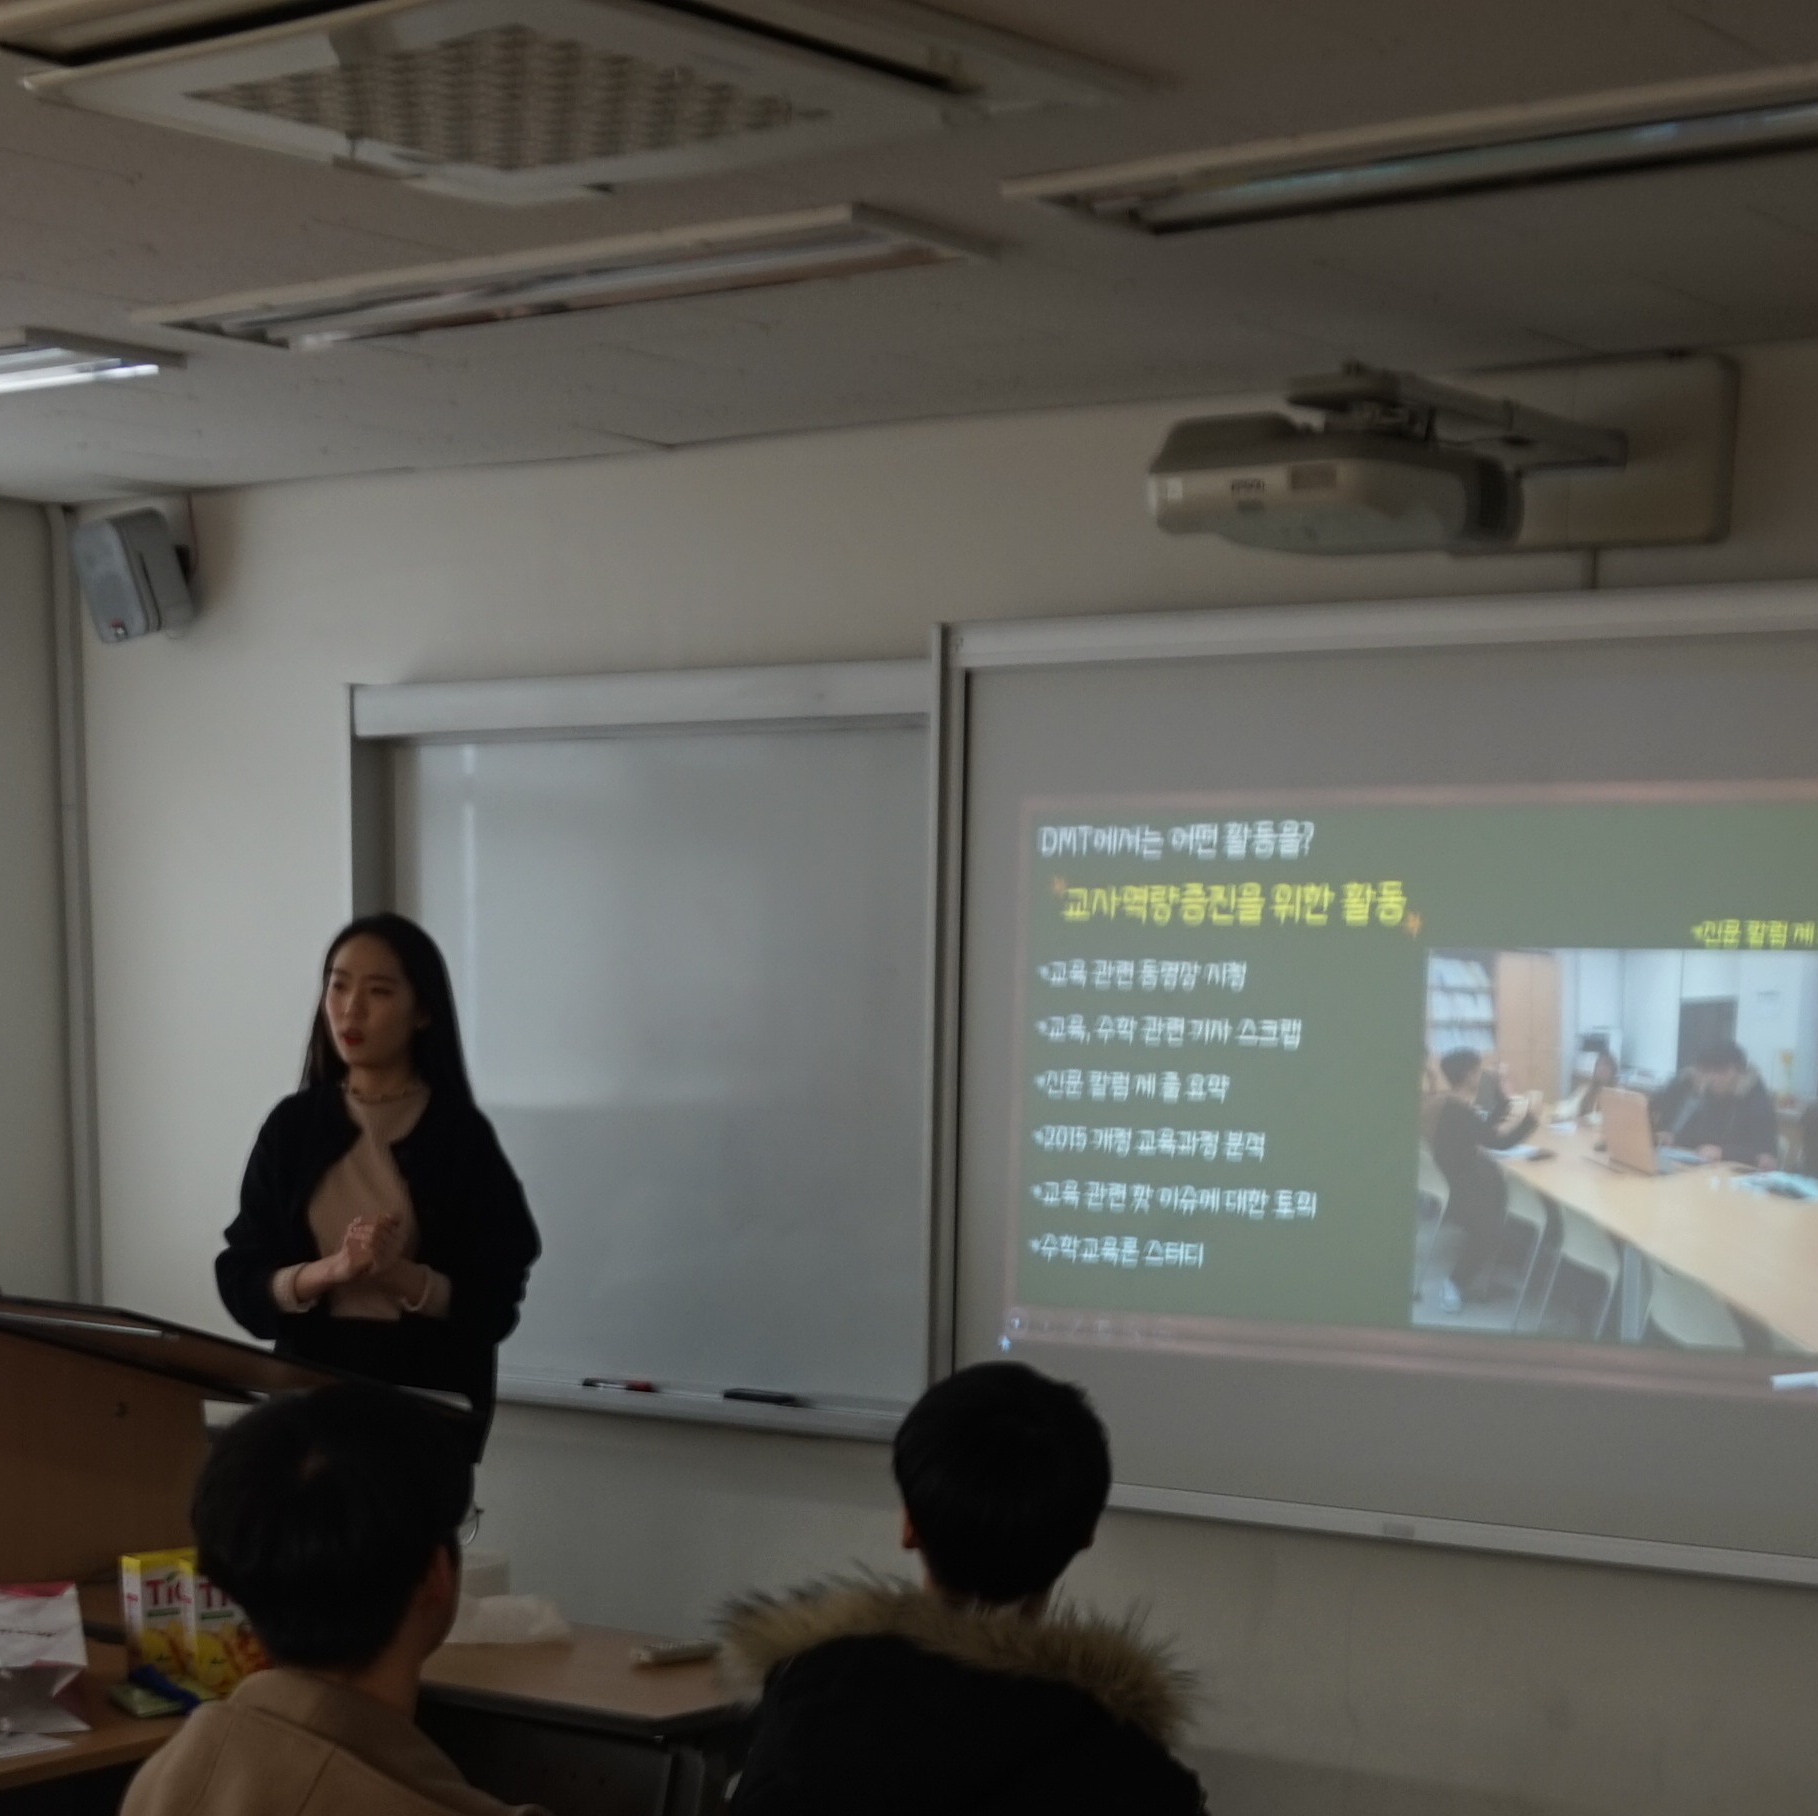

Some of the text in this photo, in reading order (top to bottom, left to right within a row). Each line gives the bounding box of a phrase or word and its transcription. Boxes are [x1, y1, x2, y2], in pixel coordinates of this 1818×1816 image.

[1039, 820, 1315, 860] DMT에서는 어떤 활동을?
[1062, 880, 1407, 926] 교사역량증진을 위한 활동
[1702, 918, 1740, 949] 신문
[1048, 958, 1247, 992] 교육 관련 동영상 시청
[1048, 1015, 1302, 1051] 교육, 수학 관련 기사 스크랩
[1045, 1068, 1082, 1099] 신문
[1087, 1070, 1131, 1101] 칼럼
[1185, 1073, 1231, 1104] 요약
[1044, 1125, 1266, 1163] 2015 개정 교육과정 분석
[1041, 1179, 1080, 1210] 교육
[1084, 1181, 1127, 1213] 관련
[1156, 1184, 1221, 1215] 이슈에
[1224, 1187, 1270, 1220] 대한
[1040, 1233, 1205, 1269] 수학교육론 스터디
